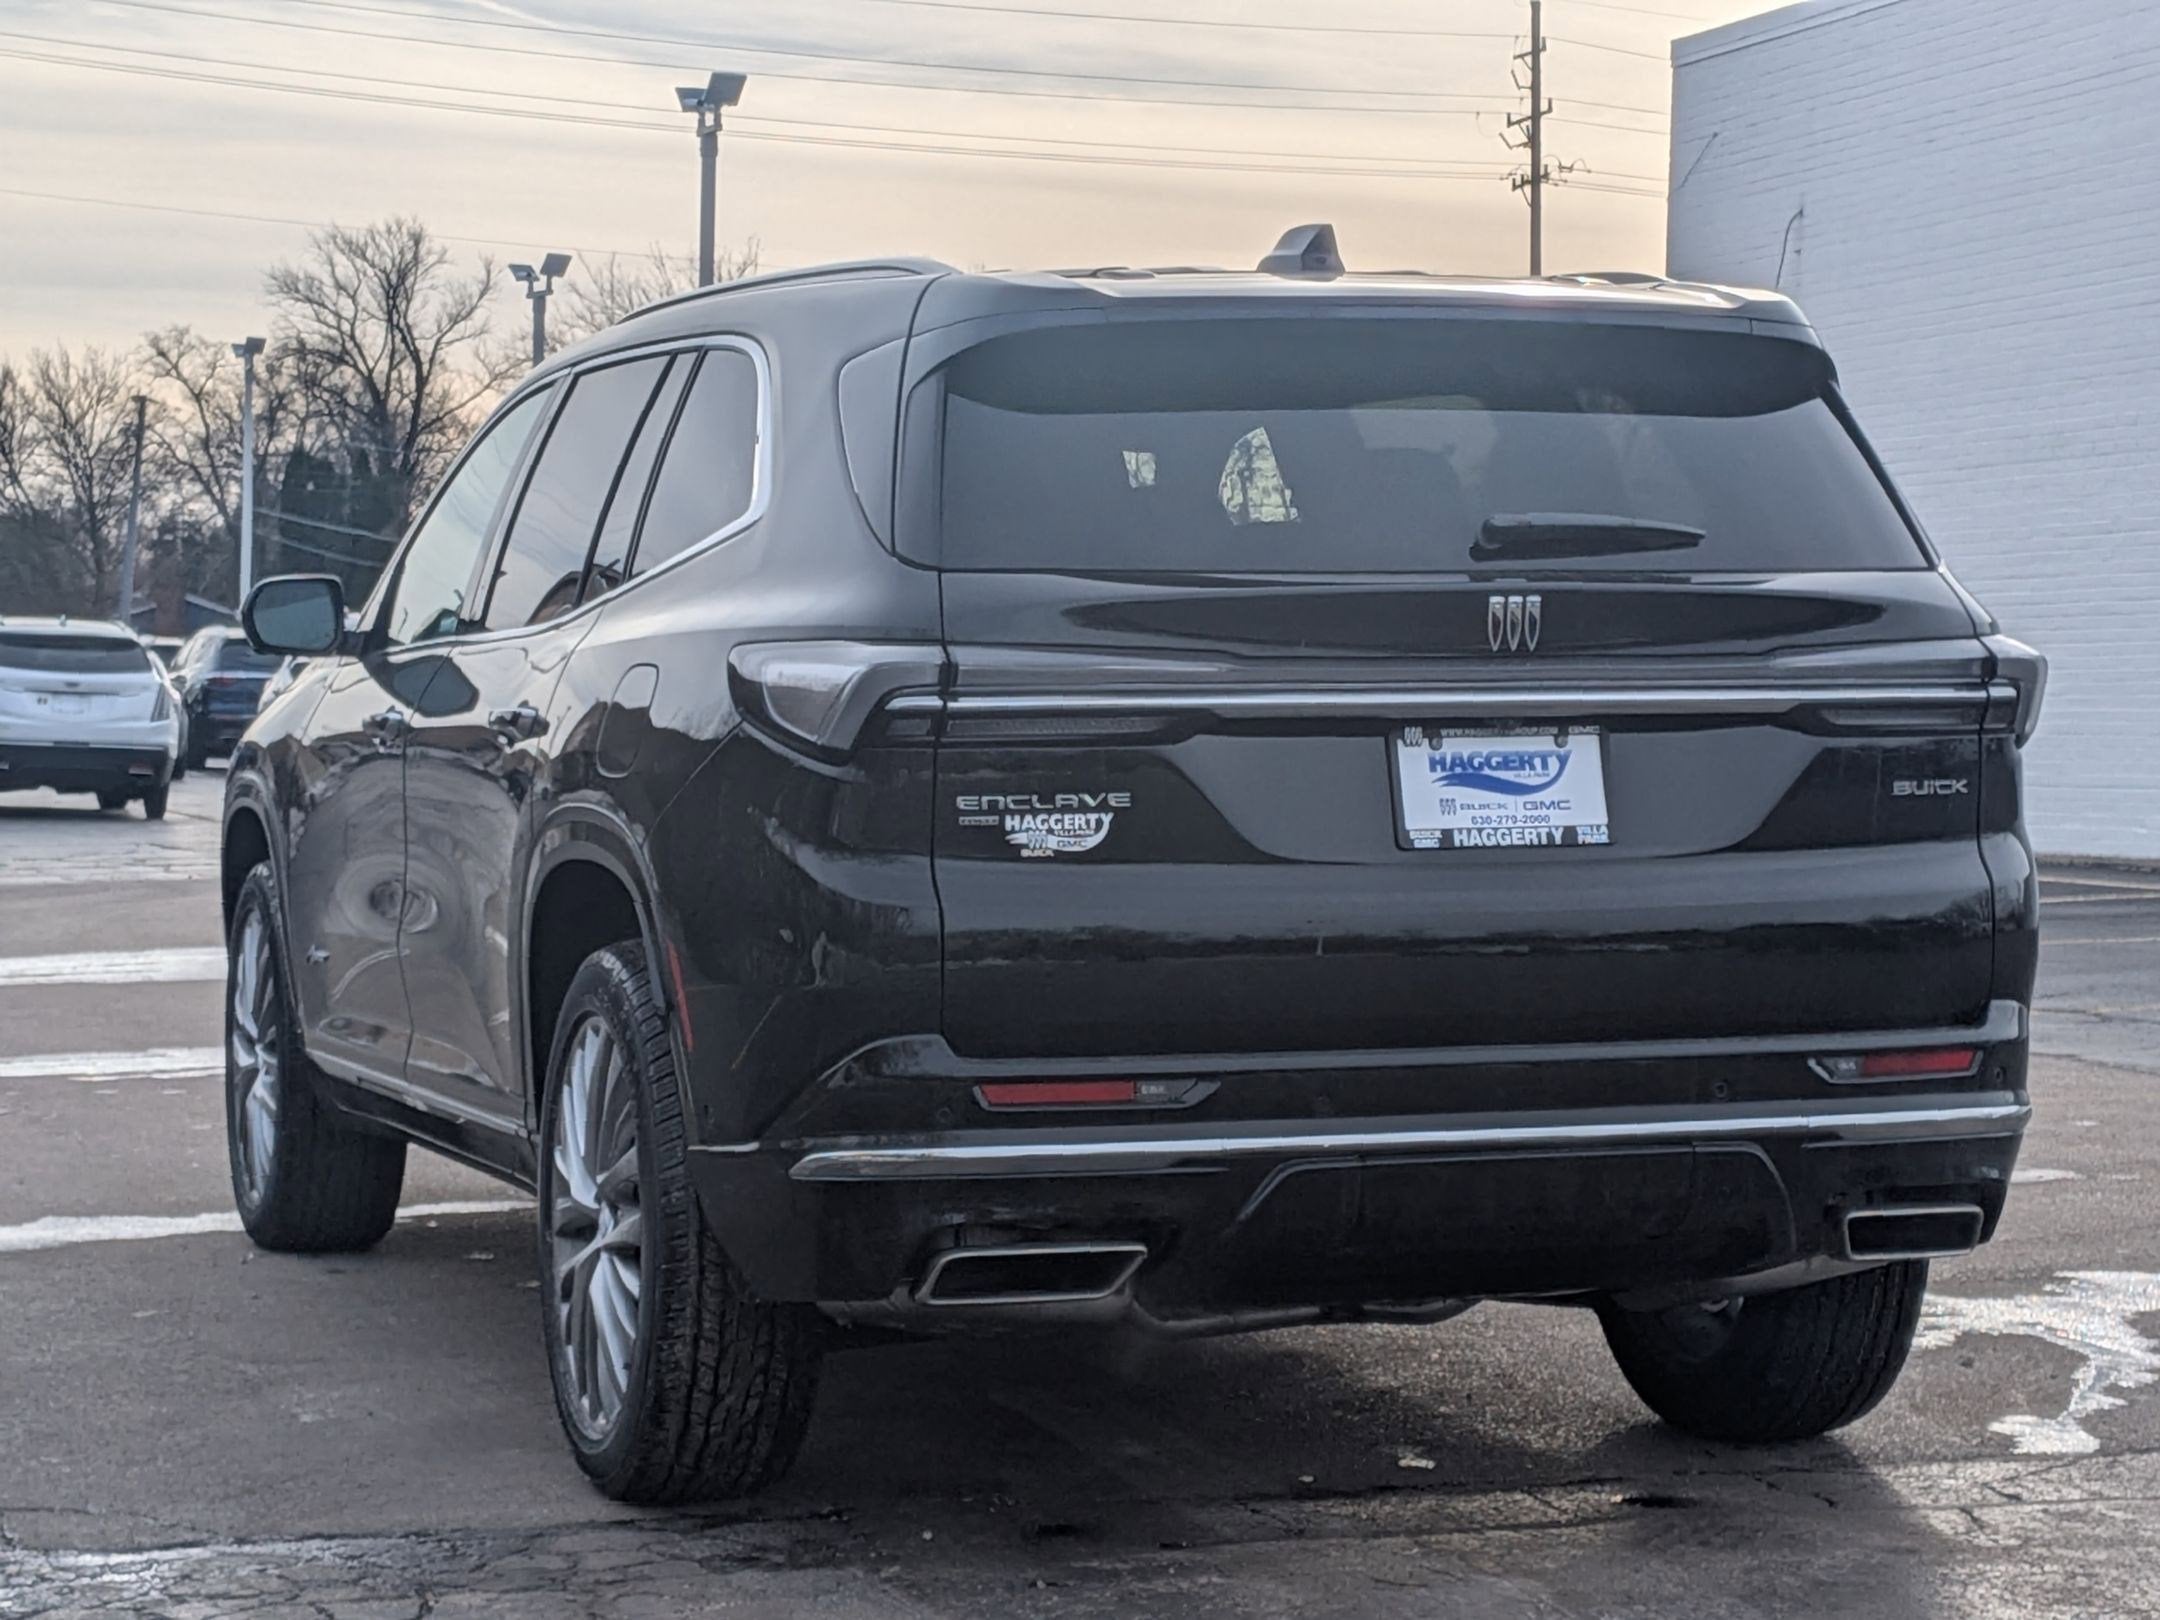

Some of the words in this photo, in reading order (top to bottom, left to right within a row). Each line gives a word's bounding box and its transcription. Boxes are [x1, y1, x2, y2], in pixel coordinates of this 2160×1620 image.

[1568, 725, 1600, 735] GMC
[1427, 750, 1573, 773] HAGGERTY
[1891, 779, 1969, 796] BUICK
[956, 792, 1132, 811] ENCLAVE
[1459, 801, 1508, 811] BUICK
[1523, 799, 1572, 811] GMC
[1004, 812, 1115, 832] HAGGERTY
[1576, 825, 1609, 835] VILLA
[1057, 839, 1088, 848] GMC
[1452, 827, 1565, 848] HAGGERTY
[1020, 849, 1054, 858] BUICK
